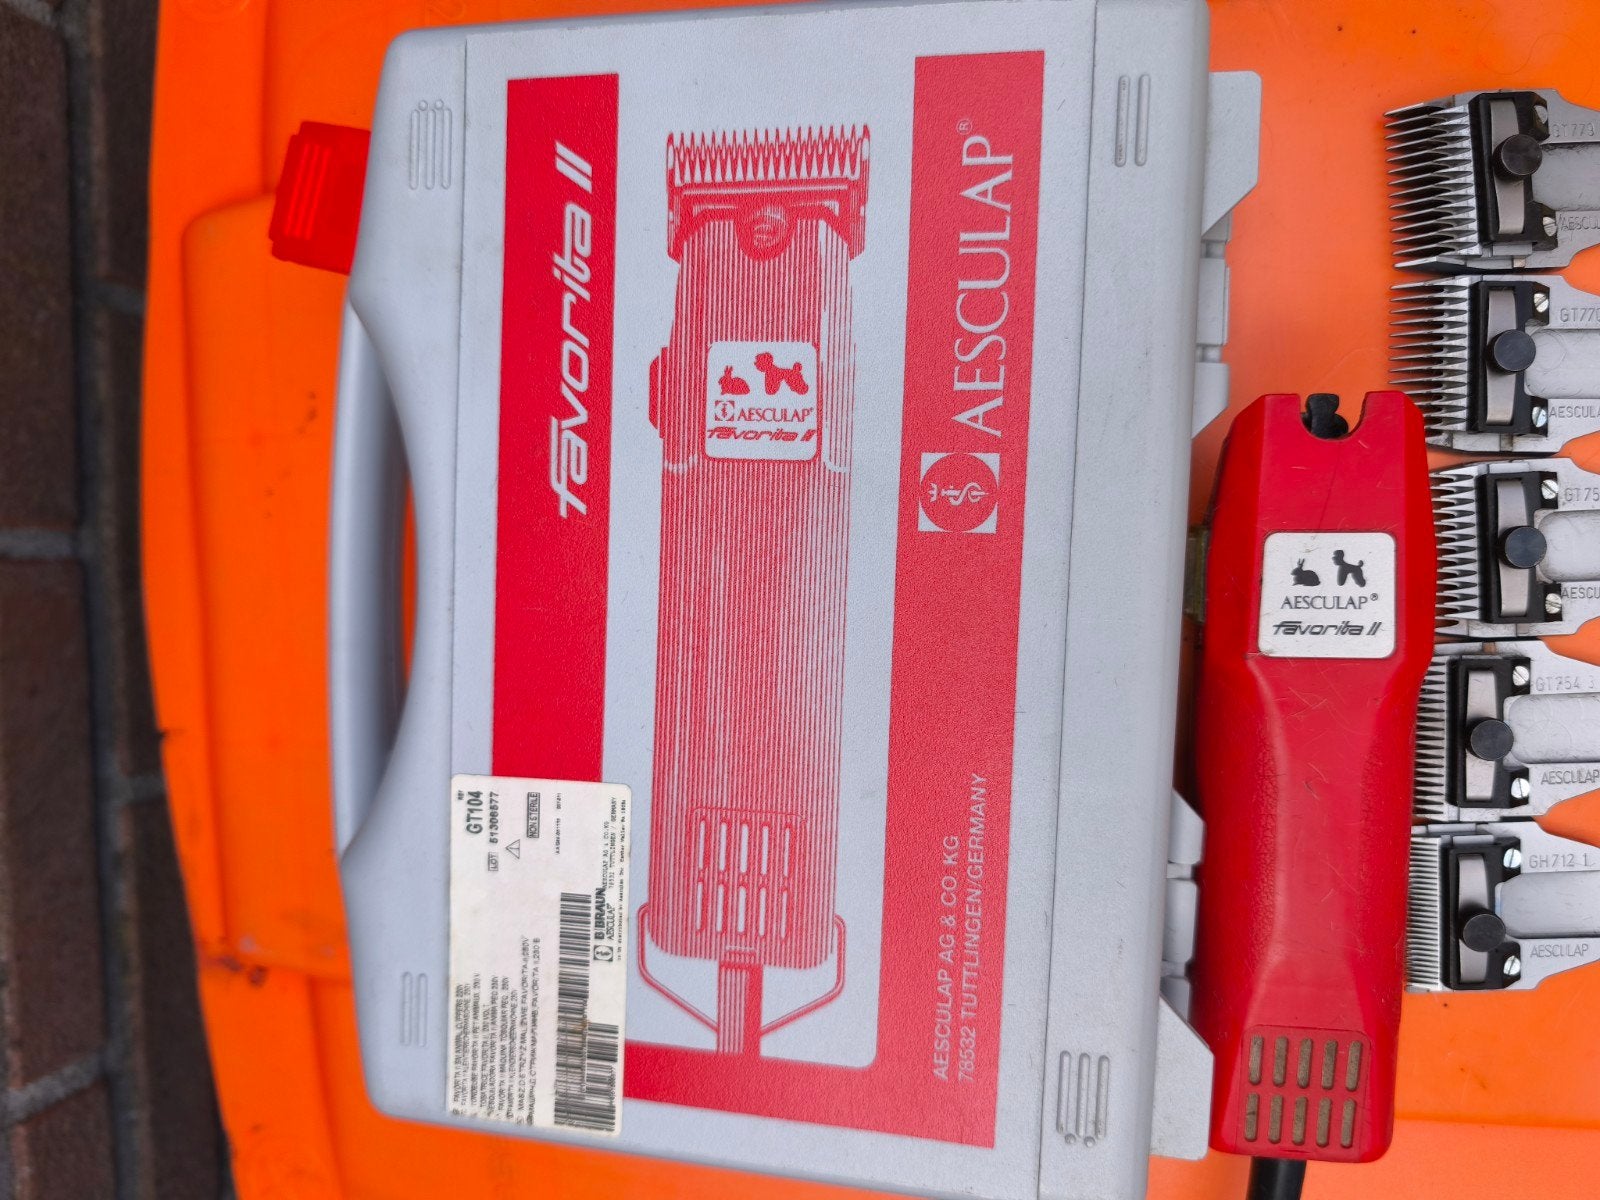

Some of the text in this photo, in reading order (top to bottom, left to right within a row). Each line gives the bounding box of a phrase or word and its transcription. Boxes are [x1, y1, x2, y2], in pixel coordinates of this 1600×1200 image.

[1540, 769, 1600, 785] AESCULAP
[466, 791, 483, 834] GT104
[529, 793, 538, 821] STERILE
[943, 835, 960, 866] KG
[939, 915, 956, 927] &
[938, 932, 955, 963] AG
[1530, 943, 1589, 958] AESCULAP
[932, 968, 952, 1082] AESCULAP
[957, 1026, 977, 1083] 78532
